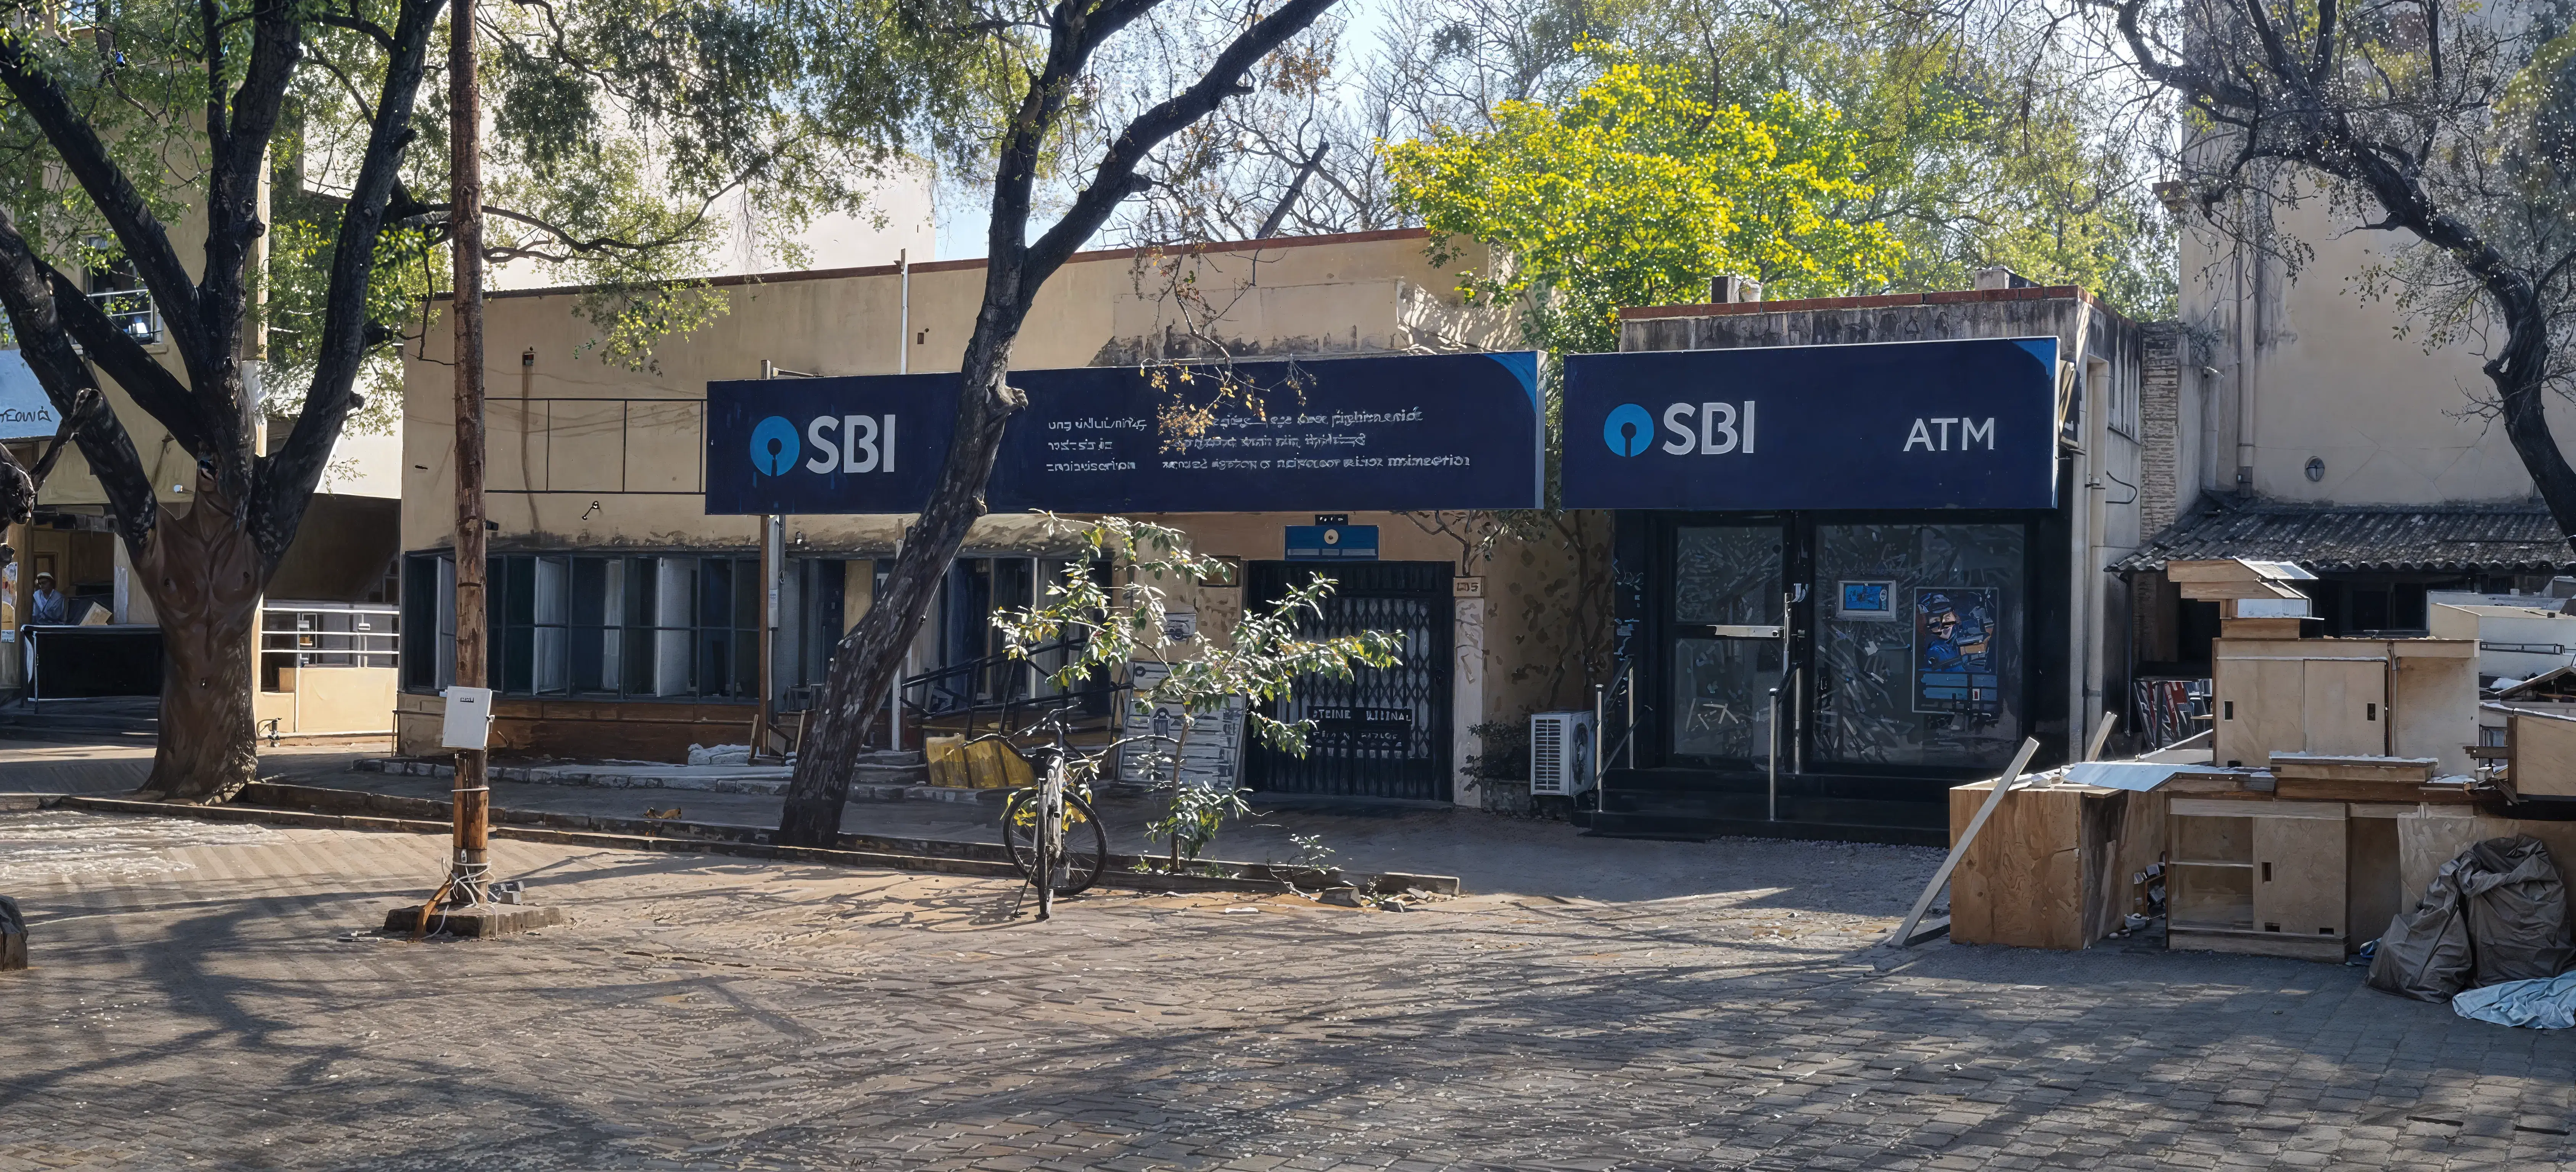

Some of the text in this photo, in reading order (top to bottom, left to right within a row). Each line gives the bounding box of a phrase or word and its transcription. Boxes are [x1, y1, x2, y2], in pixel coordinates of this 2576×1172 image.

[806, 414, 895, 474] SBI
[1663, 401, 1755, 455] SBI
[1903, 417, 1995, 452] ATM
